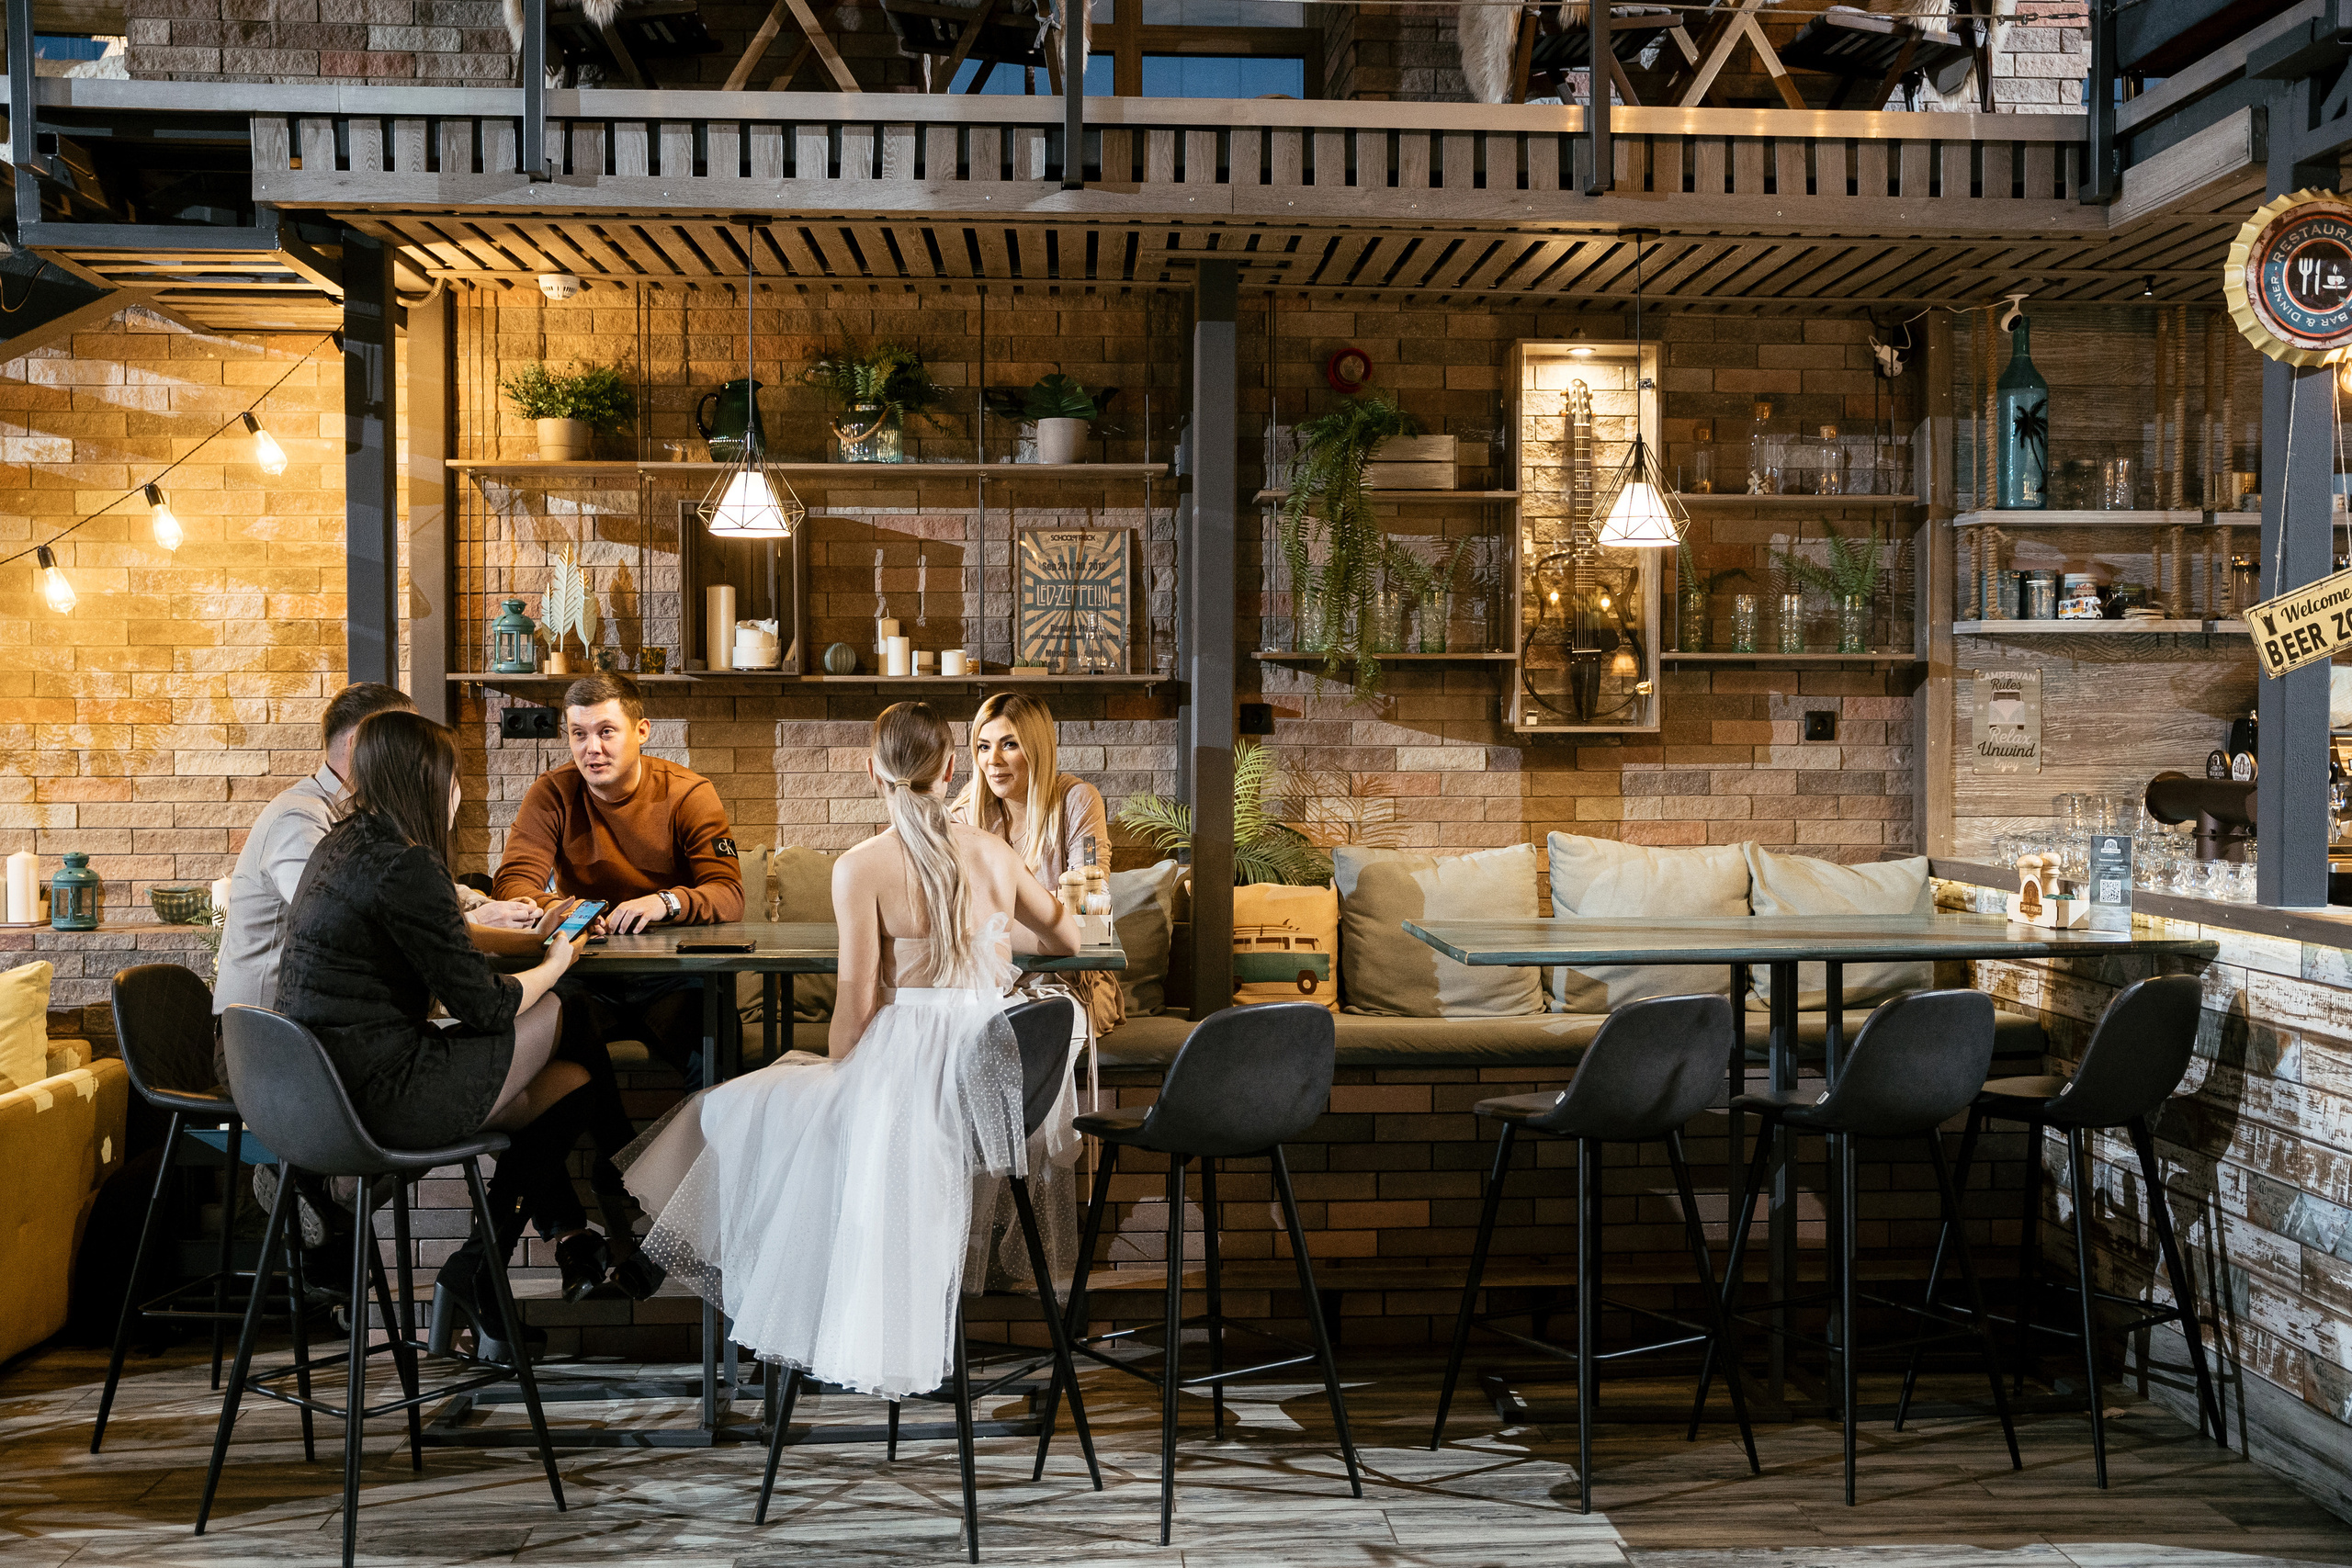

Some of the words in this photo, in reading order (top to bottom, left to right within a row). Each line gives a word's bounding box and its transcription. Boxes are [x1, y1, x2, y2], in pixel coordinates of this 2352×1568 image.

[2270, 276, 2302, 323] DINNER
[2305, 316, 2316, 328] &
[2322, 311, 2349, 327] BAR
[1042, 562, 1057, 571] Sep
[1057, 562, 1068, 571] 29
[1088, 562, 1106, 571] 2012
[2280, 587, 2352, 624] Welcome
[2265, 622, 2328, 668] BEER
[1978, 671, 2036, 682] CAMPERVAN
[1991, 678, 2024, 691] Rules
[1988, 727, 2032, 745] Relax
[1977, 740, 2036, 758] Unwind
[1993, 758, 2020, 773] Enjoy
